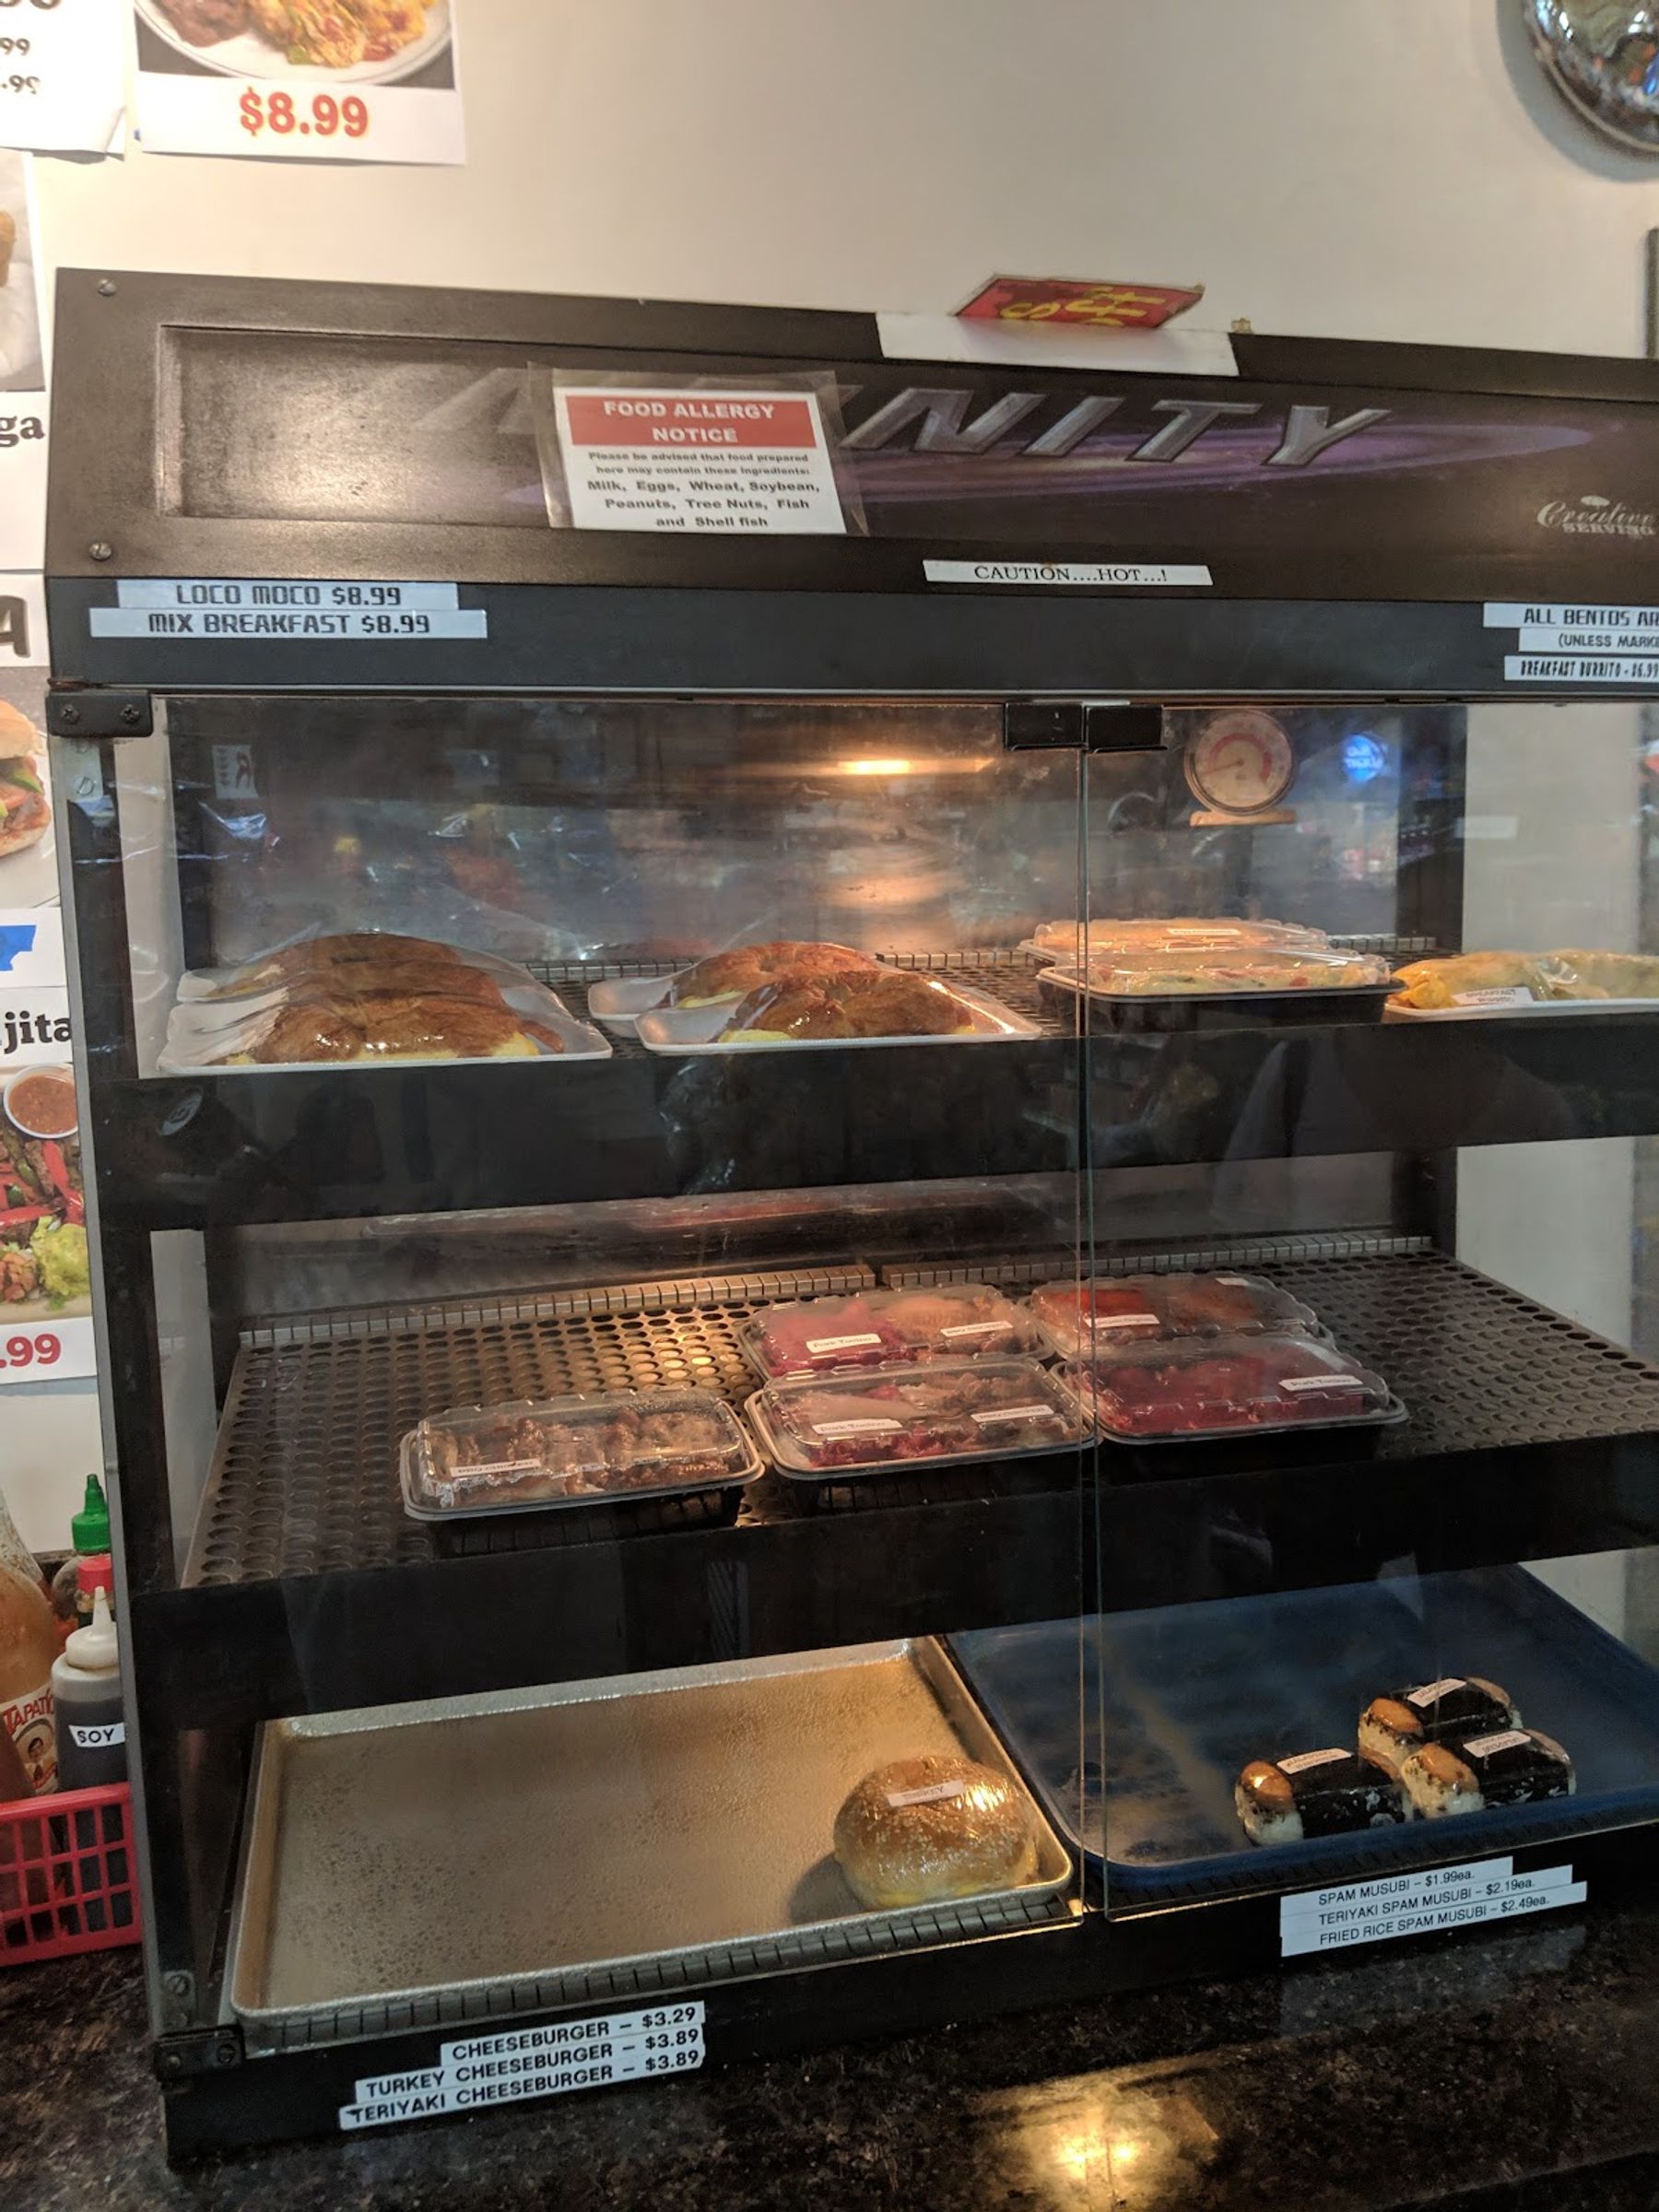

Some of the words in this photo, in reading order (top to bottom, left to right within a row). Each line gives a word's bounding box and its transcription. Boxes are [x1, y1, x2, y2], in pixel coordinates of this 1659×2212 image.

[240, 86, 369, 137] $8.99
[604, 400, 666, 417] FOOD
[674, 403, 775, 419] ALLERGY
[653, 428, 738, 443] NOTICE
[588, 452, 629, 461] Please
[632, 453, 647, 462] be
[651, 453, 698, 462] advised
[700, 453, 724, 462] that
[727, 453, 754, 463] food
[757, 454, 808, 465] prepared
[595, 465, 624, 476] here
[627, 467, 652, 477] may
[655, 466, 701, 476] contain
[704, 466, 736, 476] these
[740, 466, 810, 477] ingredients:
[587, 480, 627, 492] Milk,
[636, 481, 680, 493] Eggs,
[689, 481, 745, 492] Wheat,
[749, 481, 820, 493] Soybean,
[605, 499, 677, 511] Peanuts,
[685, 499, 722, 510] Tree
[726, 499, 768, 511] Nuts,
[777, 499, 809, 510] Fish
[655, 516, 685, 527] and
[695, 517, 735, 527] Shell
[739, 517, 768, 527] fish
[177, 584, 241, 606] LOCO
[253, 585, 321, 606] MOCO
[332, 586, 401, 606] $8.99
[148, 613, 194, 634] MIX
[204, 614, 350, 635] BREAKFAST
[361, 615, 430, 634] $8.99
[1524, 608, 1556, 625] ALL
[1563, 609, 1630, 626] BENTOS
[1558, 633, 1612, 648] (UNLESS
[1521, 660, 1576, 677] BREAKFAST
[1580, 661, 1621, 677] BURRITO
[77, 1728, 114, 1743] SOY
[1319, 1889, 1356, 1906] SPAM
[1360, 1879, 1410, 1900] MUSUBI
[1425, 1869, 1475, 1888] $1.99ea.
[1319, 1906, 1378, 1926] TERIYAKI
[1382, 1898, 1418, 1914] SPAM
[1422, 1888, 1472, 1907] MUSUBI
[1486, 1877, 1535, 1897] $2.19ea.
[1320, 1928, 1360, 1946] FRIED
[1364, 1923, 1394, 1938] RICE
[1398, 1916, 1434, 1932] SPAM
[1438, 1906, 1487, 1925] MUSUBI
[1500, 1895, 1549, 1914] $2.49ea.
[453, 2021, 610, 2061] CHEESEBURGER
[641, 2006, 696, 2028] $3.29
[366, 2071, 445, 2098] TURKEY
[456, 2043, 613, 2083] CHEESEBURGER
[645, 2029, 699, 2050] $3.89
[347, 2095, 445, 2124] TERIYAKI
[456, 2065, 613, 2105] CHEESEBURGER
[645, 2050, 700, 2072] $3.89
